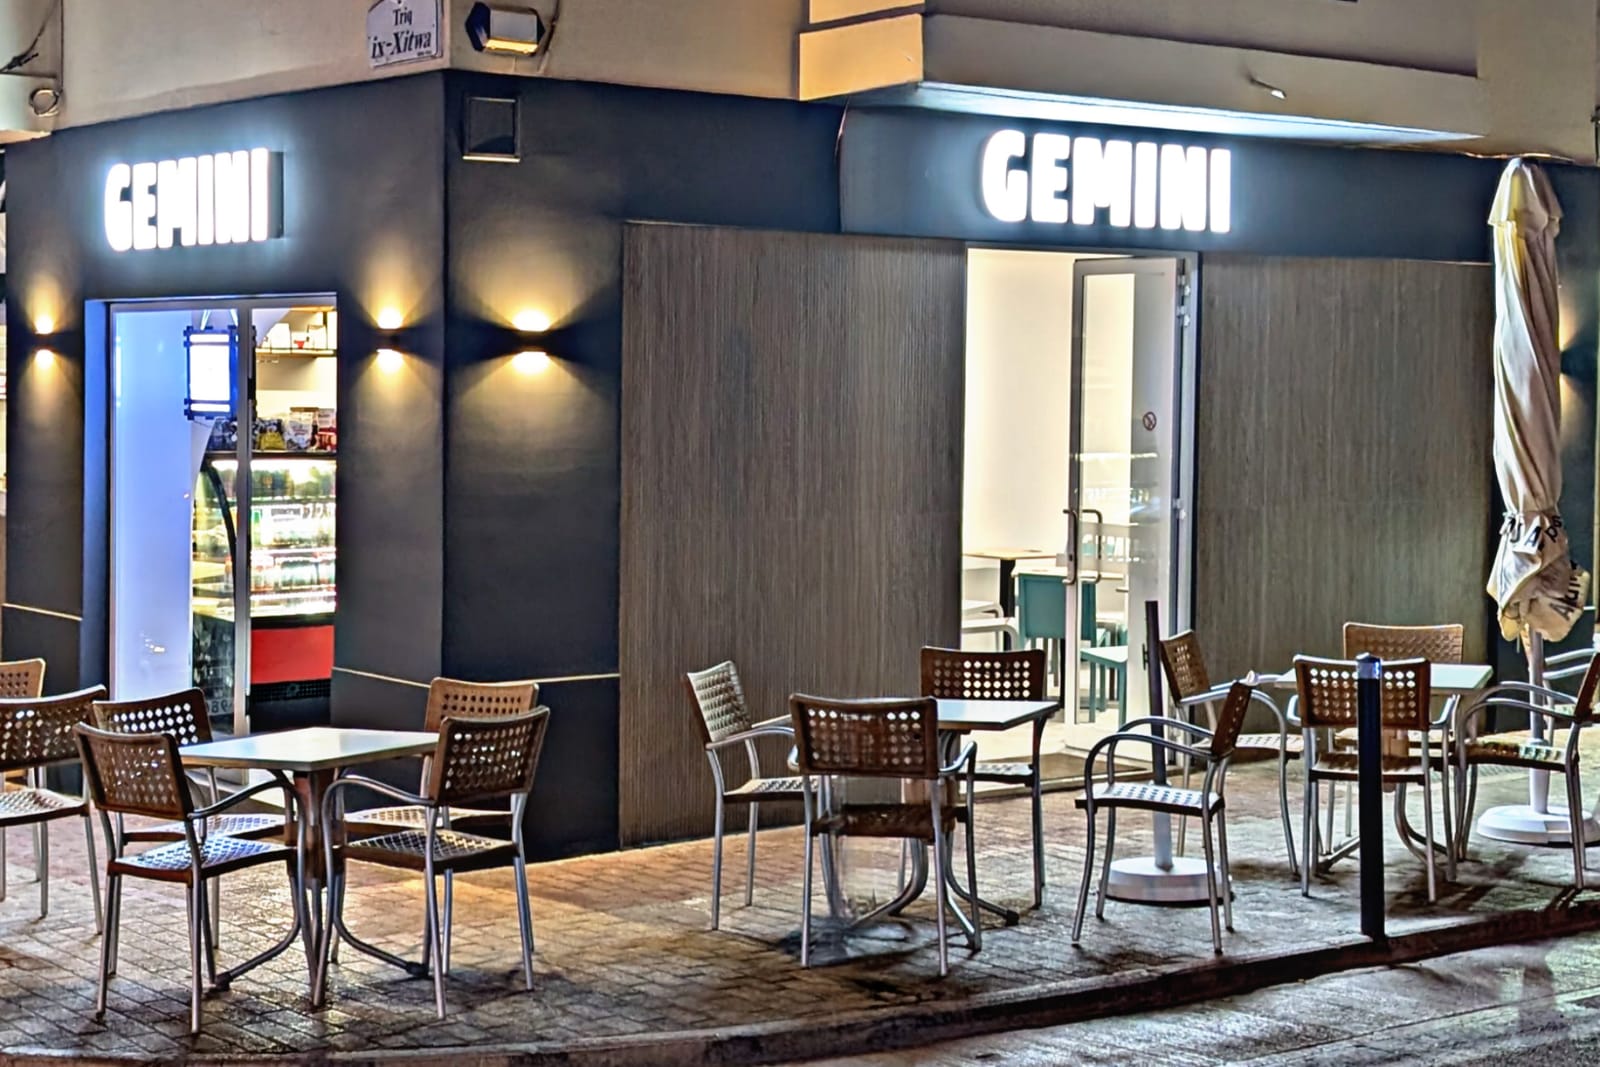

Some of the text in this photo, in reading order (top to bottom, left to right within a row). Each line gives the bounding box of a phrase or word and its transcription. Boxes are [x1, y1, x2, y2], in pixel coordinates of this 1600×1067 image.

[371, 30, 432, 59] ix-Xitwa
[392, 7, 413, 26] Triq
[104, 147, 269, 252] GEMINI
[982, 129, 1232, 234] GEMINI
